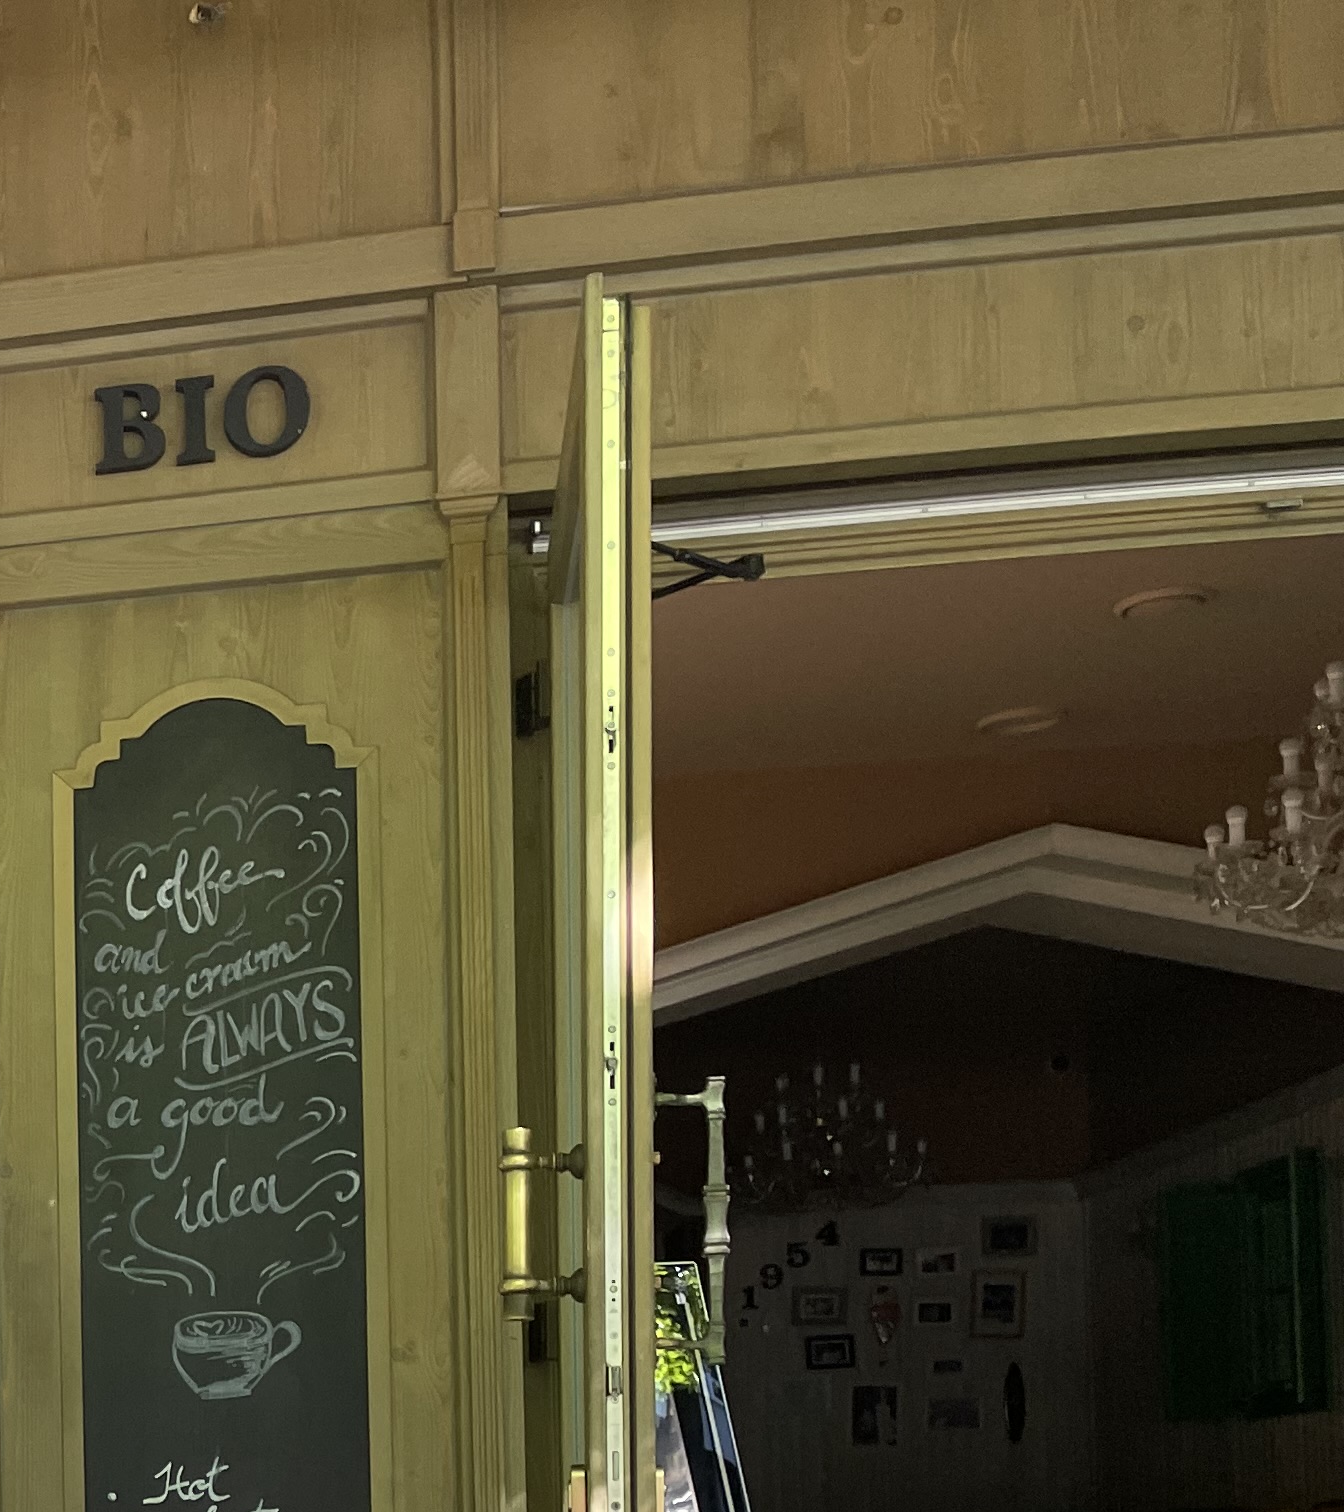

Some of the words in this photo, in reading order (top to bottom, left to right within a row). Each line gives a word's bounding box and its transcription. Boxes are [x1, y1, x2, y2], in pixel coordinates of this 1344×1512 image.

[94, 365, 311, 476] BIO
[125, 846, 285, 934] Coffee
[94, 929, 167, 976] and
[114, 982, 179, 1020] ice
[116, 1024, 164, 1068] is
[181, 979, 346, 1074] ALWAYS
[108, 1096, 140, 1128] a
[150, 1076, 284, 1180] good
[174, 1158, 293, 1233] idea
[142, 1456, 231, 1504] Hot
